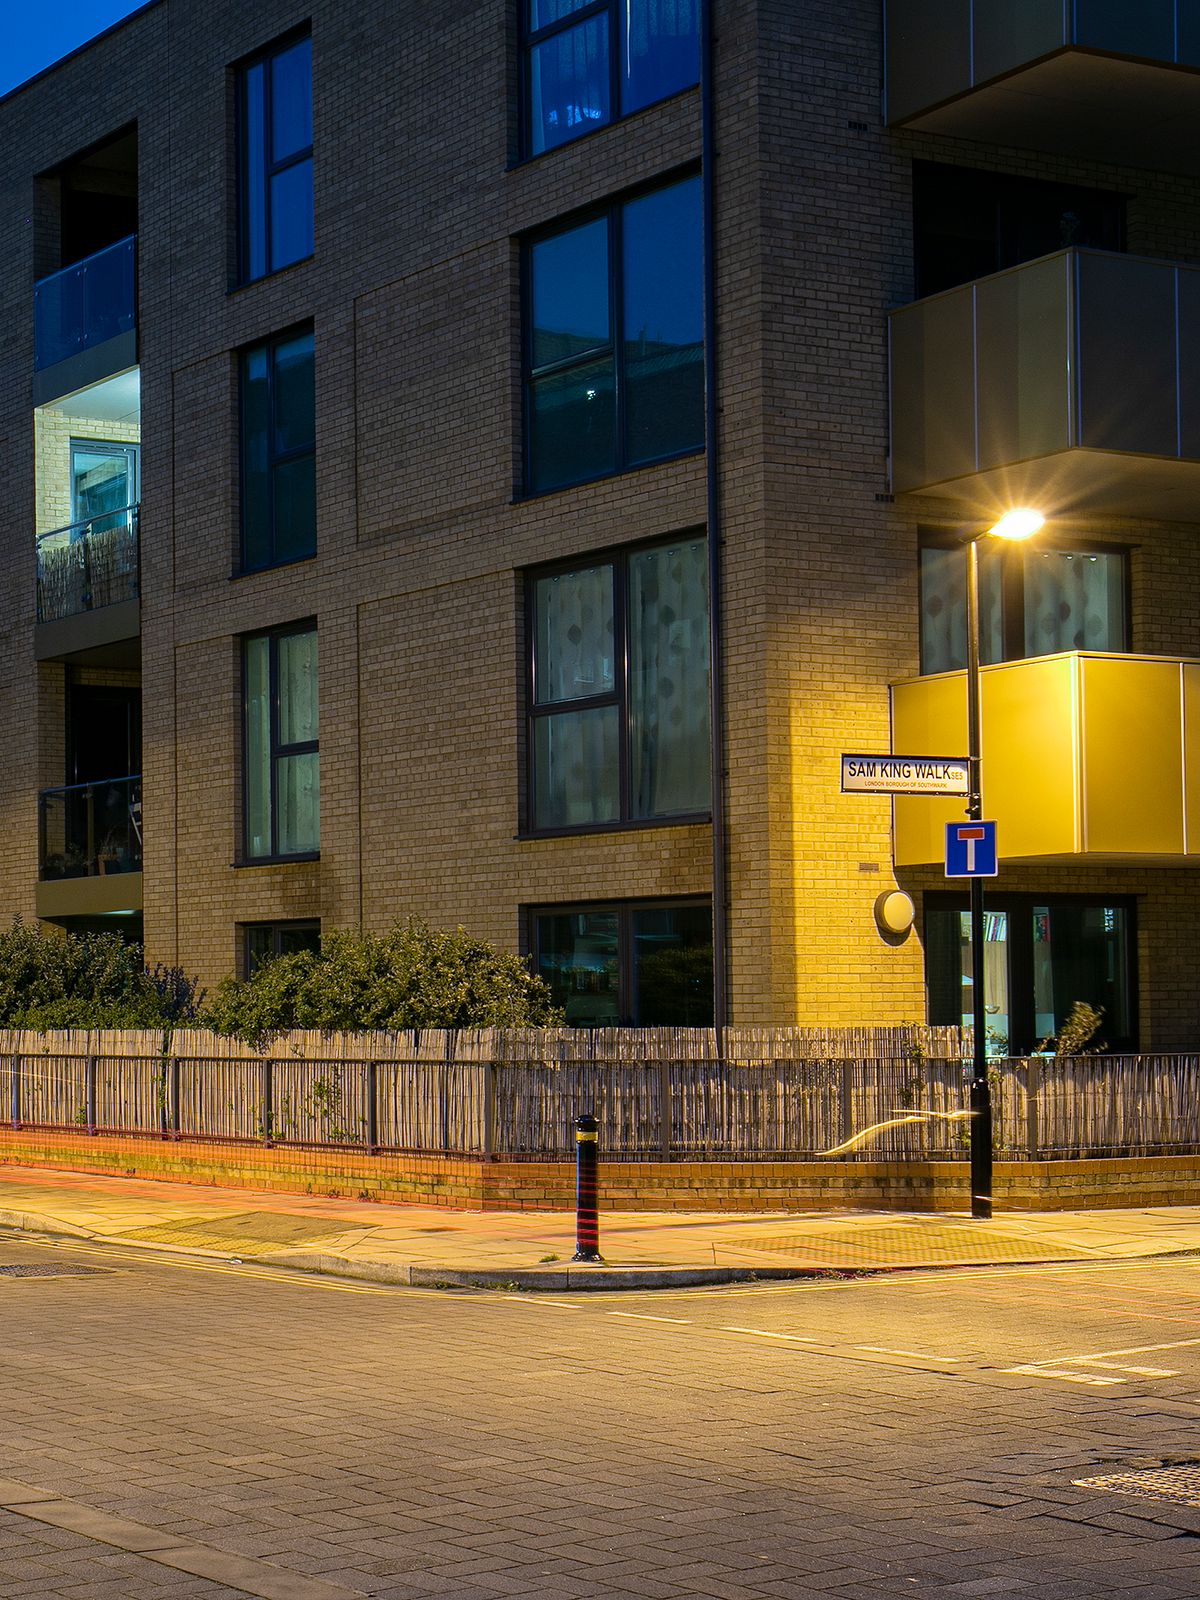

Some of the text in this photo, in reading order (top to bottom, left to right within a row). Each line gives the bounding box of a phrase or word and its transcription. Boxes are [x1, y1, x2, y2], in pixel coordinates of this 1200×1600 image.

[848, 761, 963, 780] SAM KING WALK SE5
